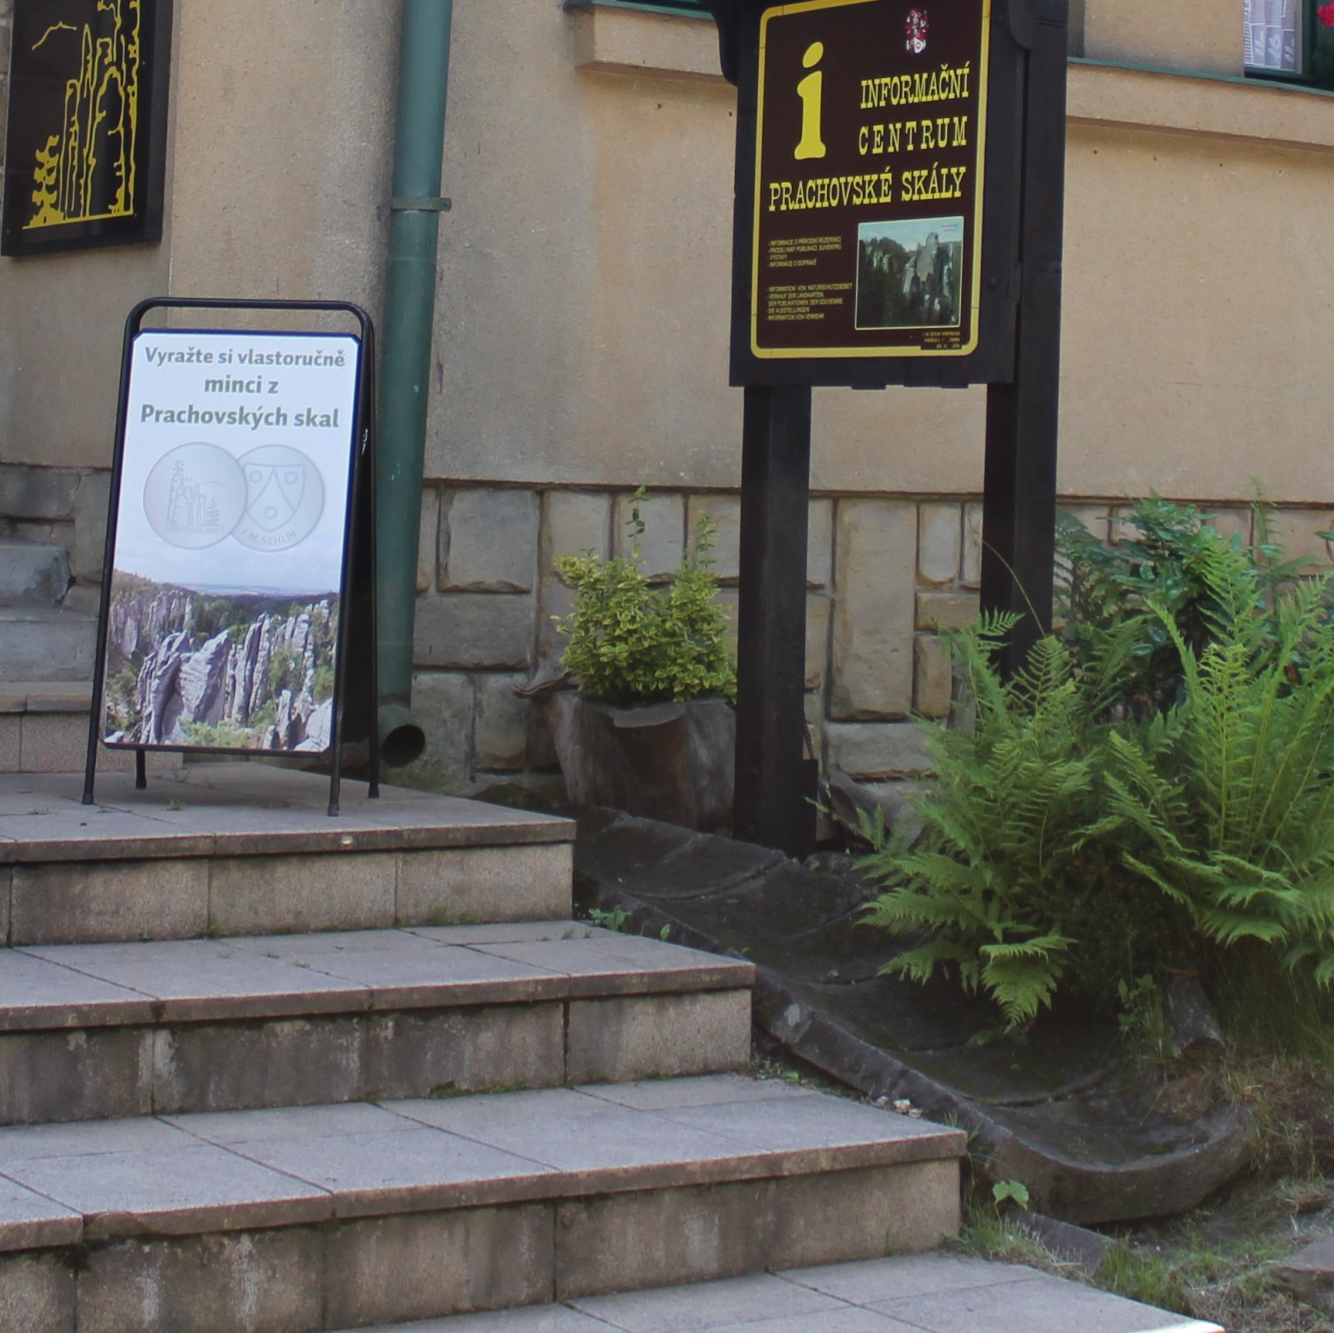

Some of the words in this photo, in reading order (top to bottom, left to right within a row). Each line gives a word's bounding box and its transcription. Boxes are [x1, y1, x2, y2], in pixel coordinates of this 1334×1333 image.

[860, 61, 970, 109] INFORMAČNÍ
[858, 116, 968, 156] CENTRUM
[769, 166, 892, 211] PRACHOVSKÉ
[901, 162, 966, 202] SKÁLY
[145, 346, 213, 367] Vyražte
[217, 349, 233, 365] si
[237, 349, 346, 367] vlastoručně
[204, 374, 262, 394] minci
[267, 381, 279, 394] z
[141, 404, 288, 431] Prachovských
[293, 408, 339, 428] skal
